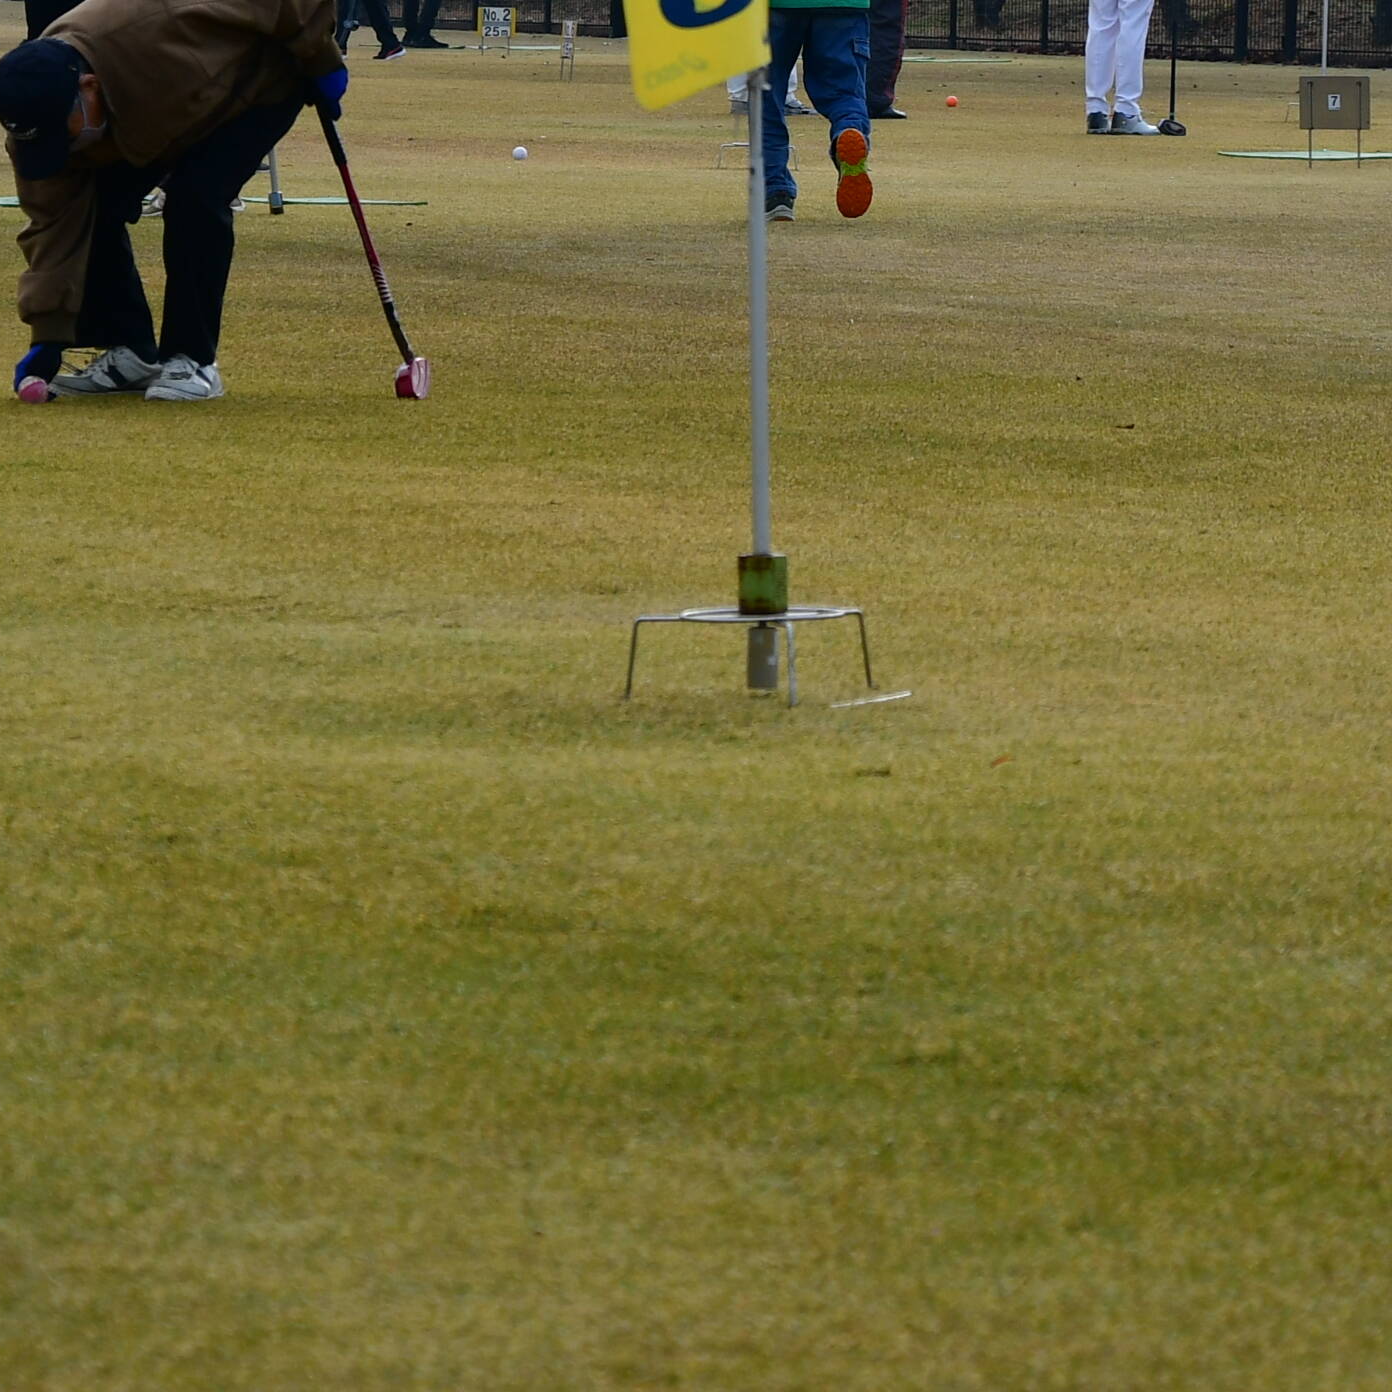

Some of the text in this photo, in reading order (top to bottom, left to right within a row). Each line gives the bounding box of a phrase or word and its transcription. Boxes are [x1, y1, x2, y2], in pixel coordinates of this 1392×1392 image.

[483, 8, 511, 22] No. 2
[484, 26, 509, 37] 25m
[1330, 95, 1338, 107] 7
